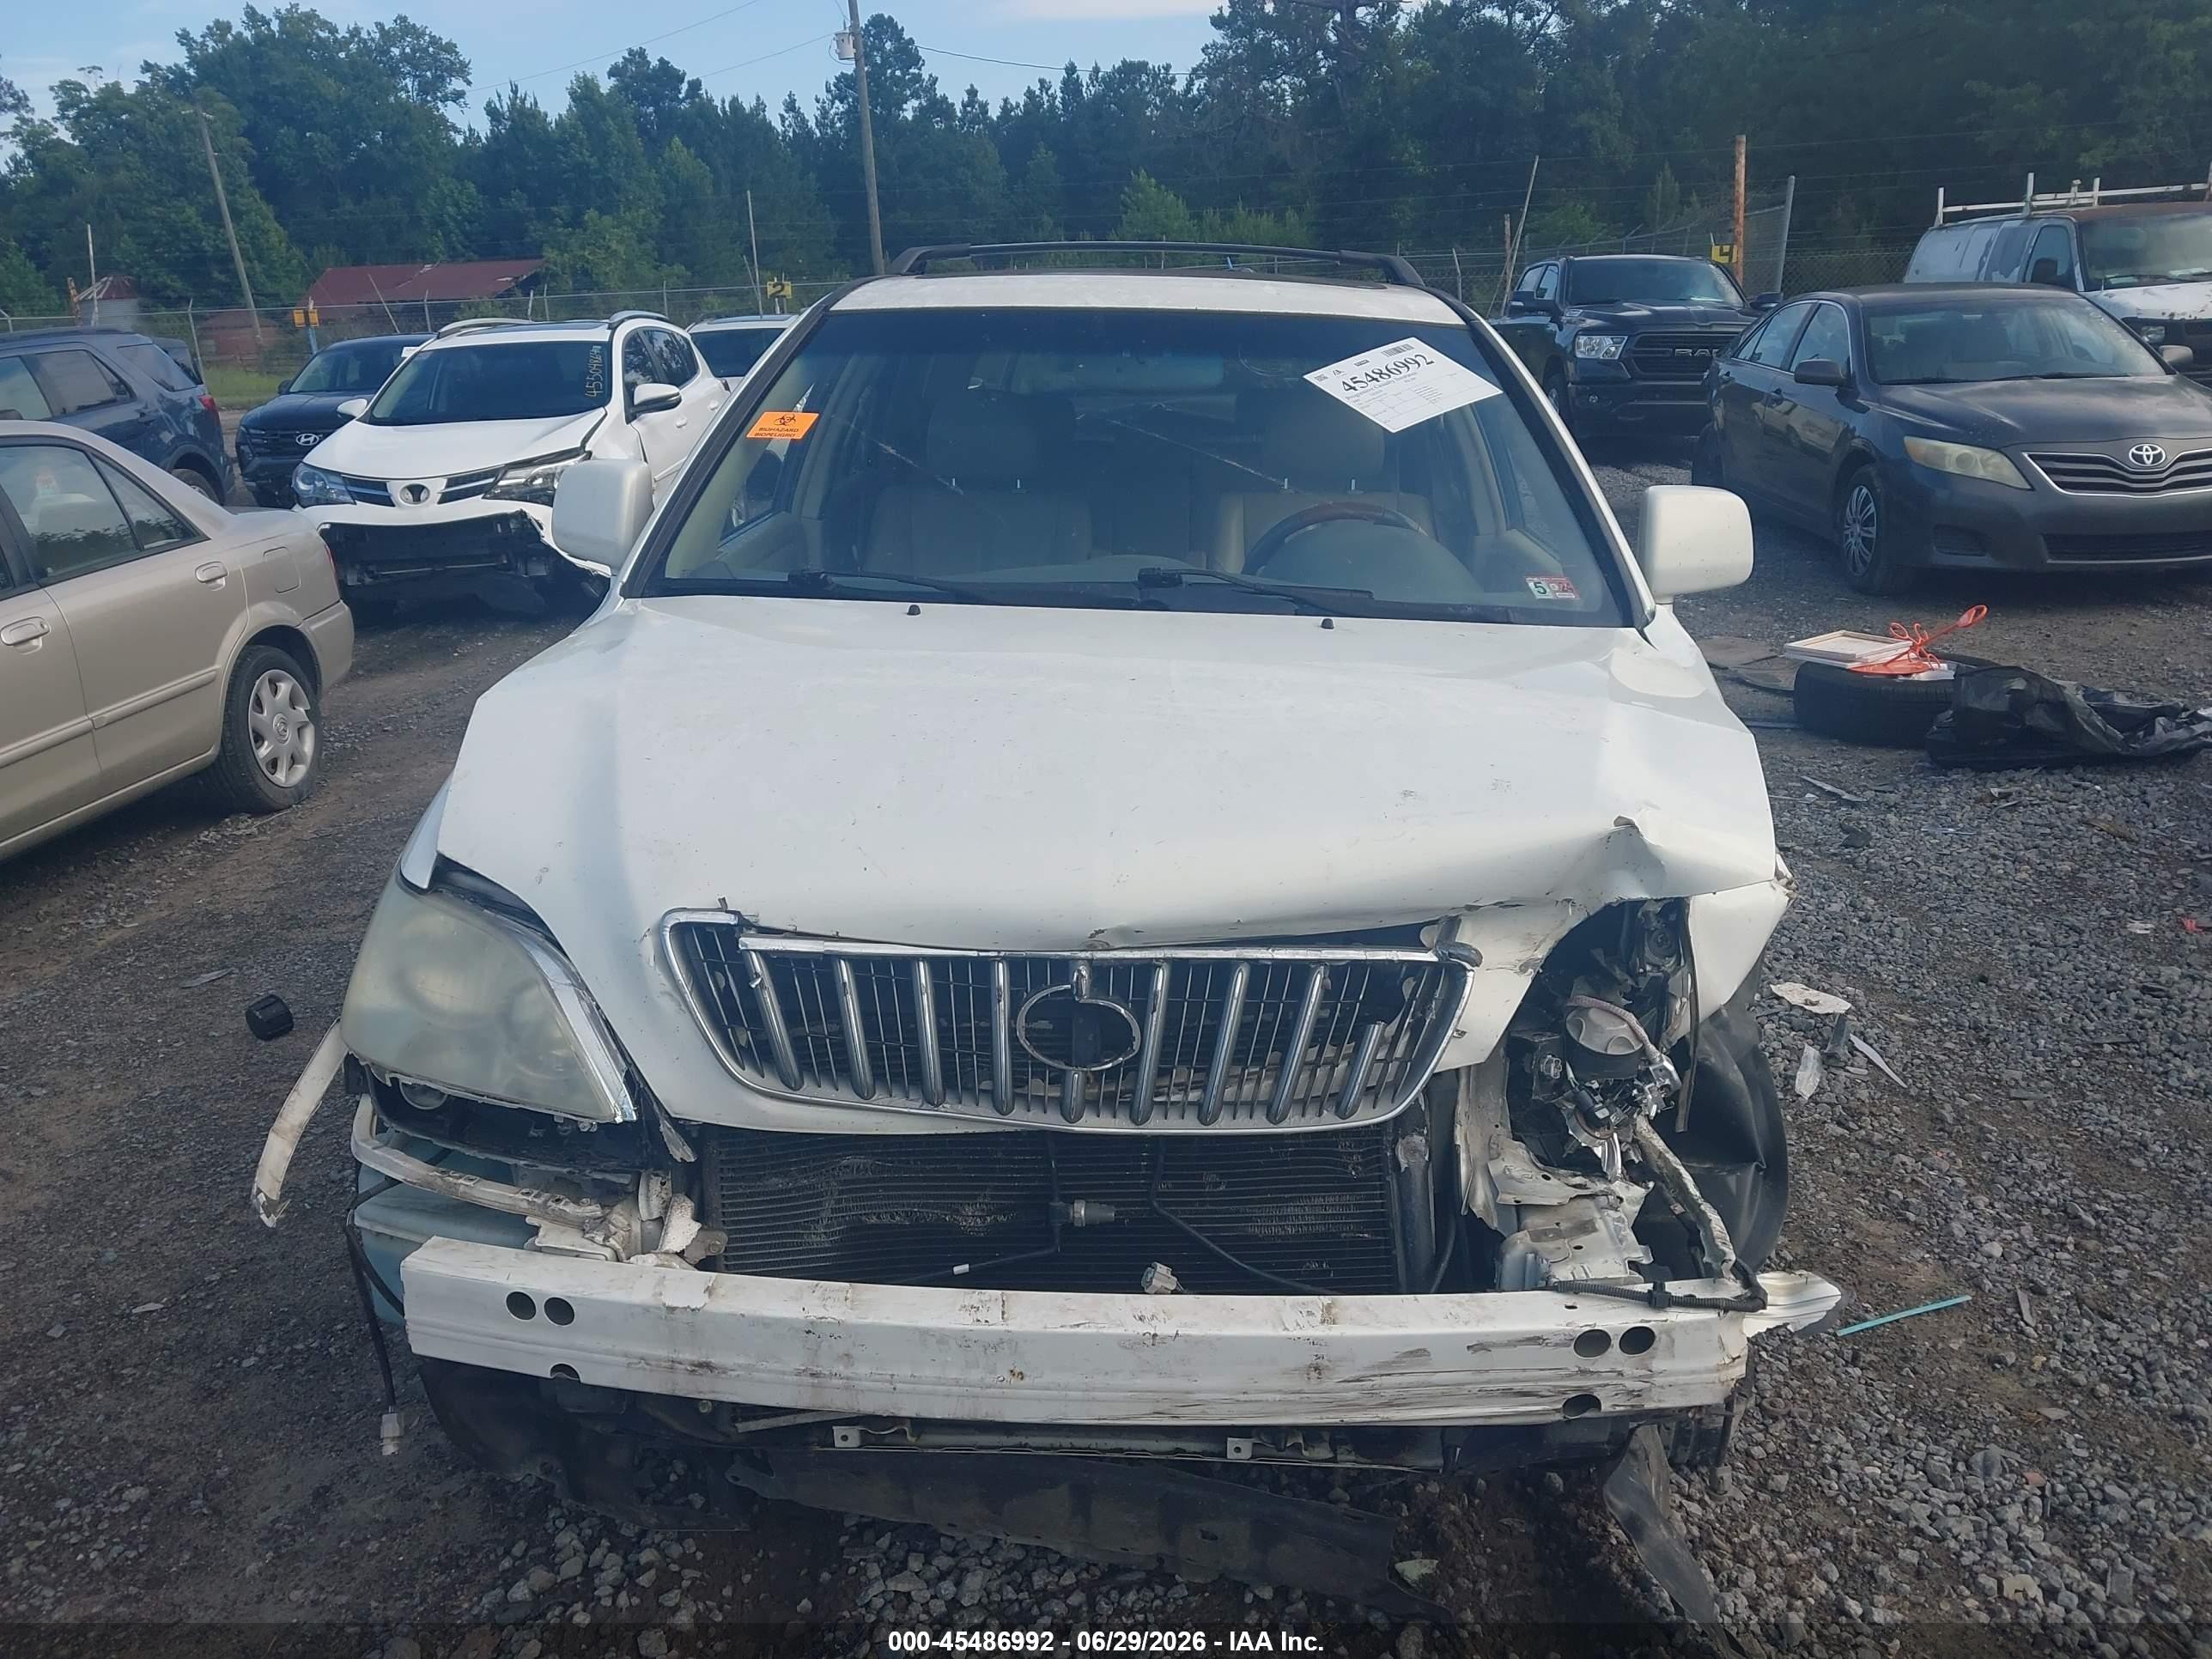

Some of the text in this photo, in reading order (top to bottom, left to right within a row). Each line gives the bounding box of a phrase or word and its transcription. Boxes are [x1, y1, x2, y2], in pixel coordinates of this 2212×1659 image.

[1719, 246, 1733, 263] 4
[769, 283, 786, 297] 2
[1342, 354, 1435, 392] 45486992
[1533, 581, 1547, 594] 5
